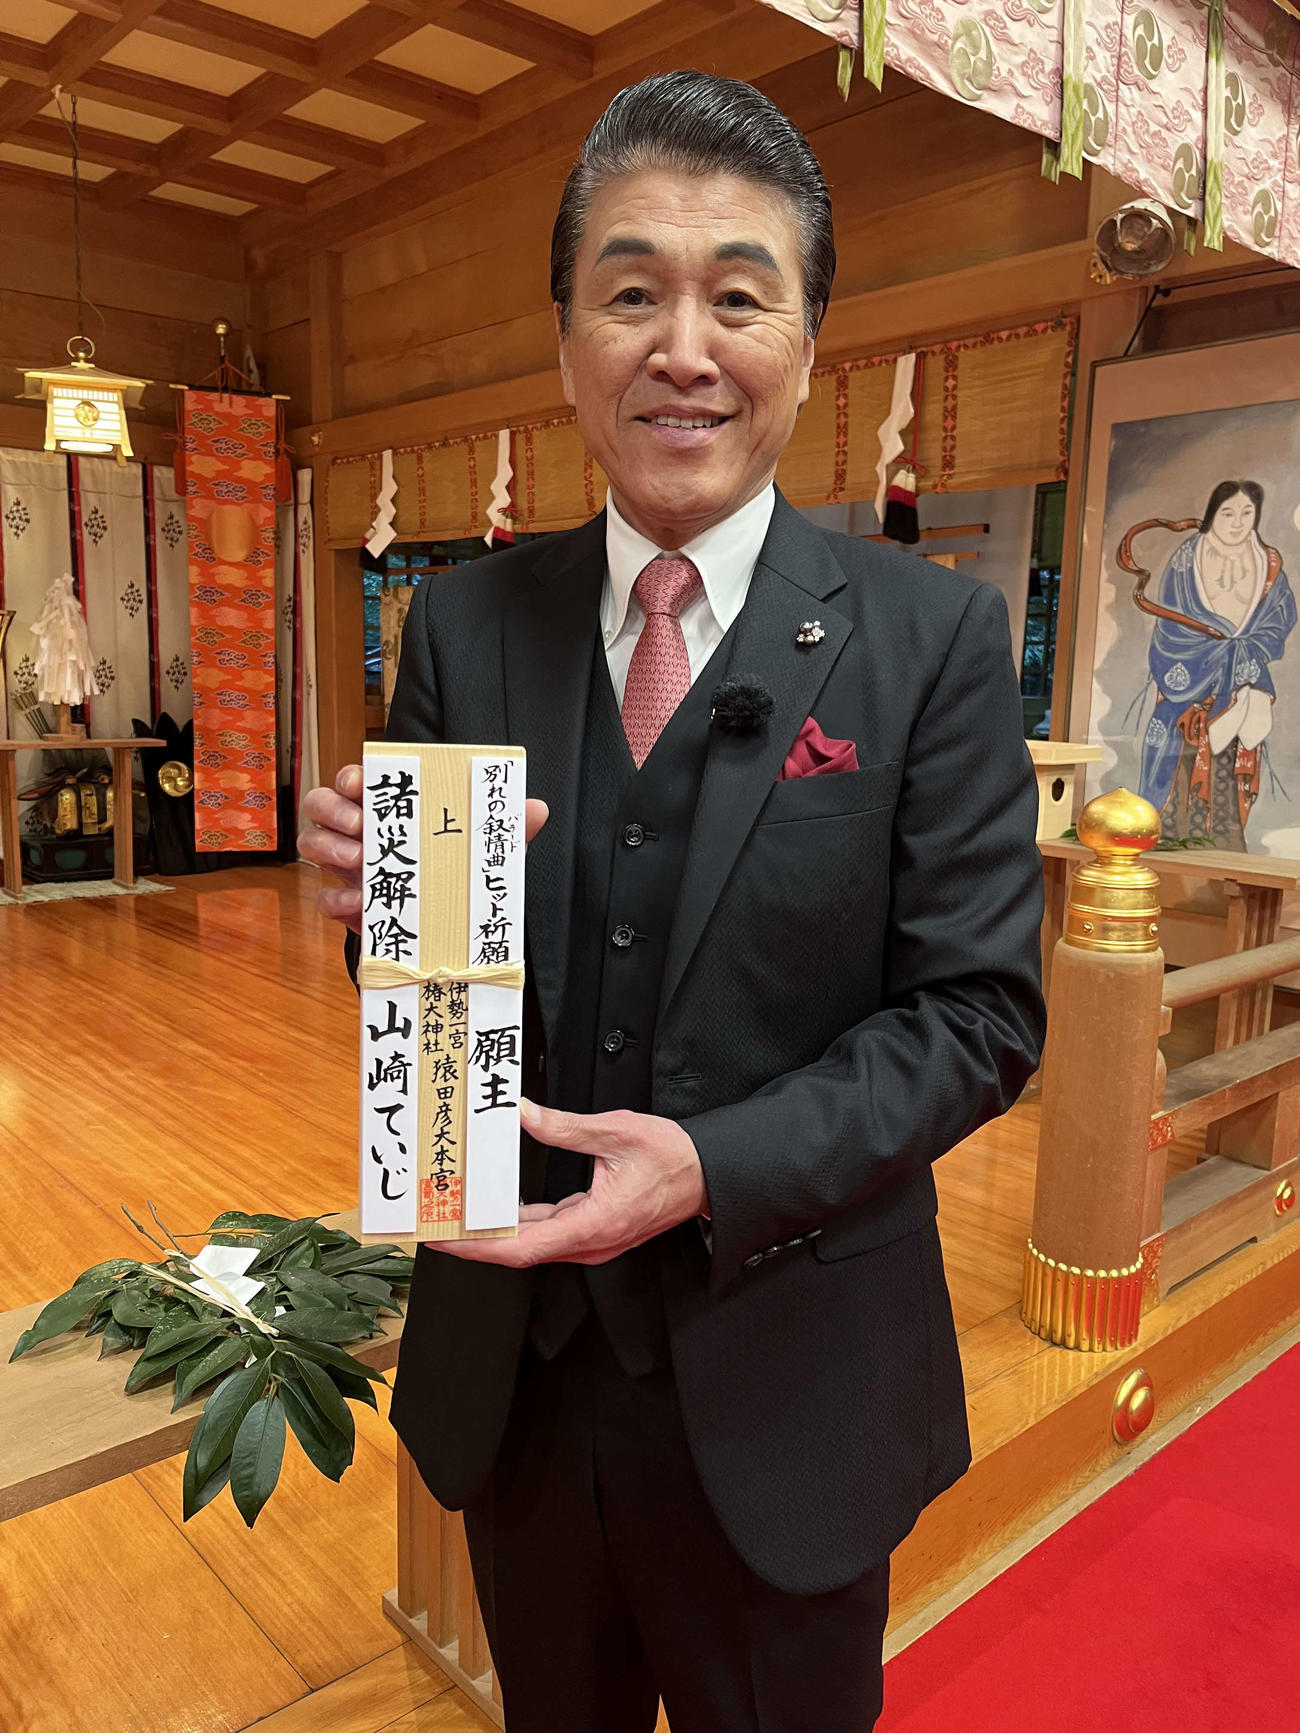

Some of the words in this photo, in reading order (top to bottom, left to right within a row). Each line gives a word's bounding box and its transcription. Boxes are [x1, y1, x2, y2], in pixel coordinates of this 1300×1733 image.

[364, 770, 419, 962] 諸災解除
[433, 807, 463, 835] 上
[421, 981, 447, 1056] 椿大神社
[447, 981, 469, 1049] 伊勢一宮
[366, 1000, 413, 1200] 山崎ていじ
[468, 1024, 521, 1114] 願主
[430, 1054, 460, 1192] 猿田彦大本宮
